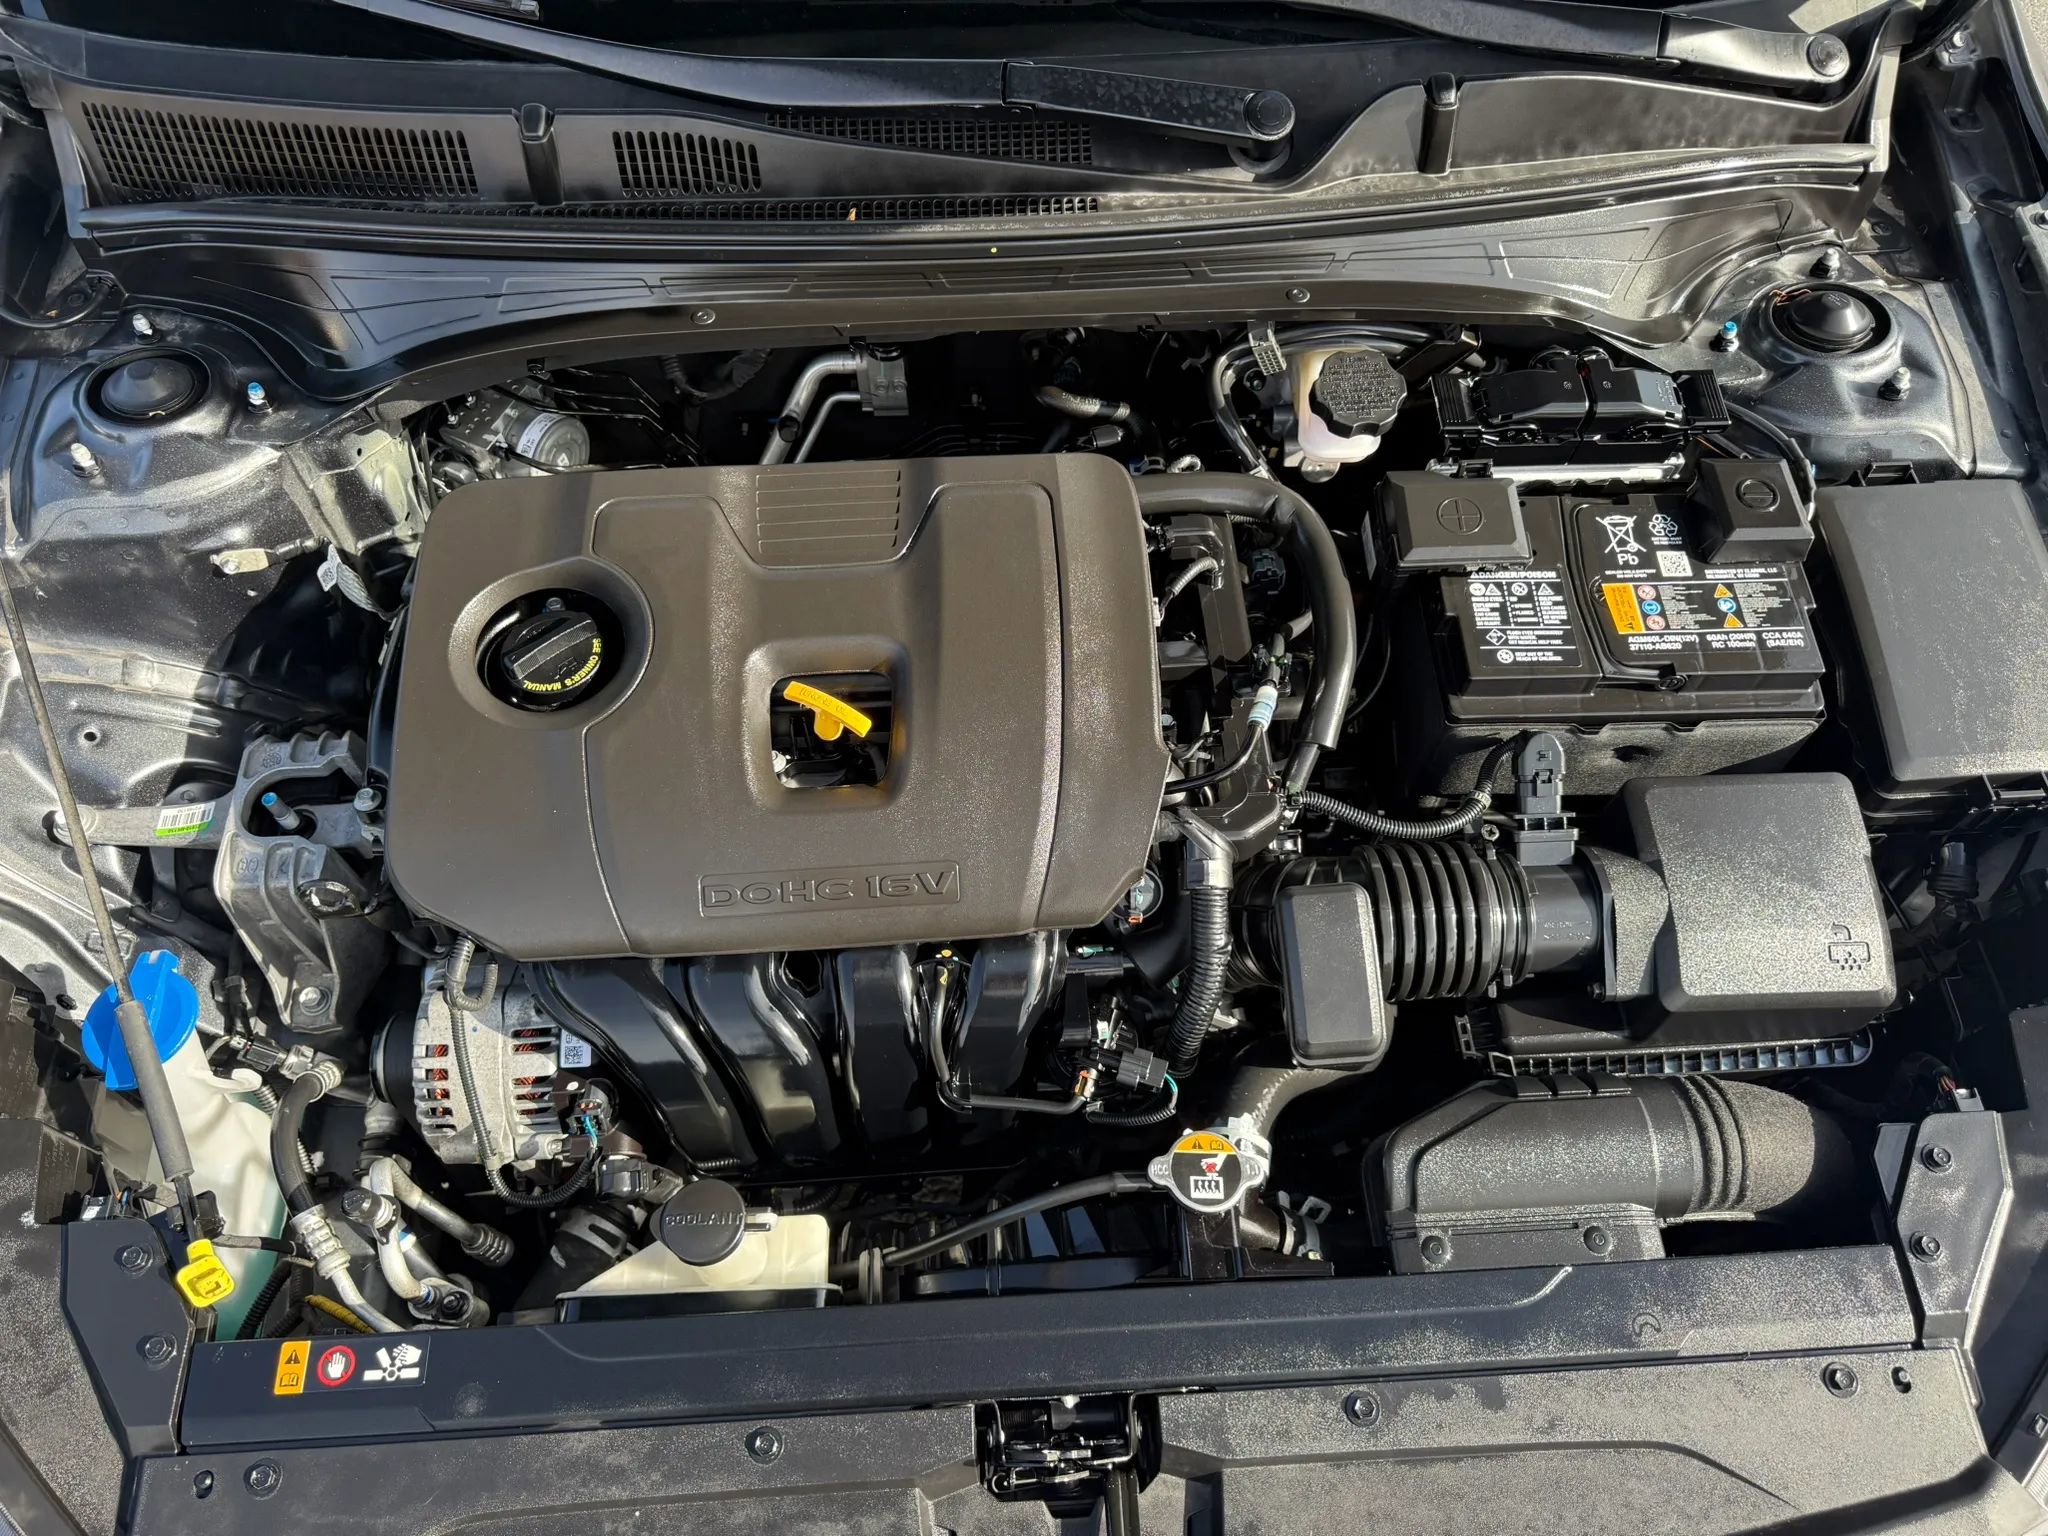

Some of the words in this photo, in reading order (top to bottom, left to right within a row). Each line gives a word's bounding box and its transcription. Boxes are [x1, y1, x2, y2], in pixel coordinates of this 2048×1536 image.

[1617, 553, 1639, 565] Pb
[592, 637, 602, 653] SEE
[564, 655, 599, 687] OWNER'S
[523, 680, 562, 692] MANUAL
[703, 878, 854, 908] DOHC
[865, 871, 955, 899] 16V
[1151, 1164, 1169, 1175] HCC
[665, 1211, 744, 1226] COOLANT
